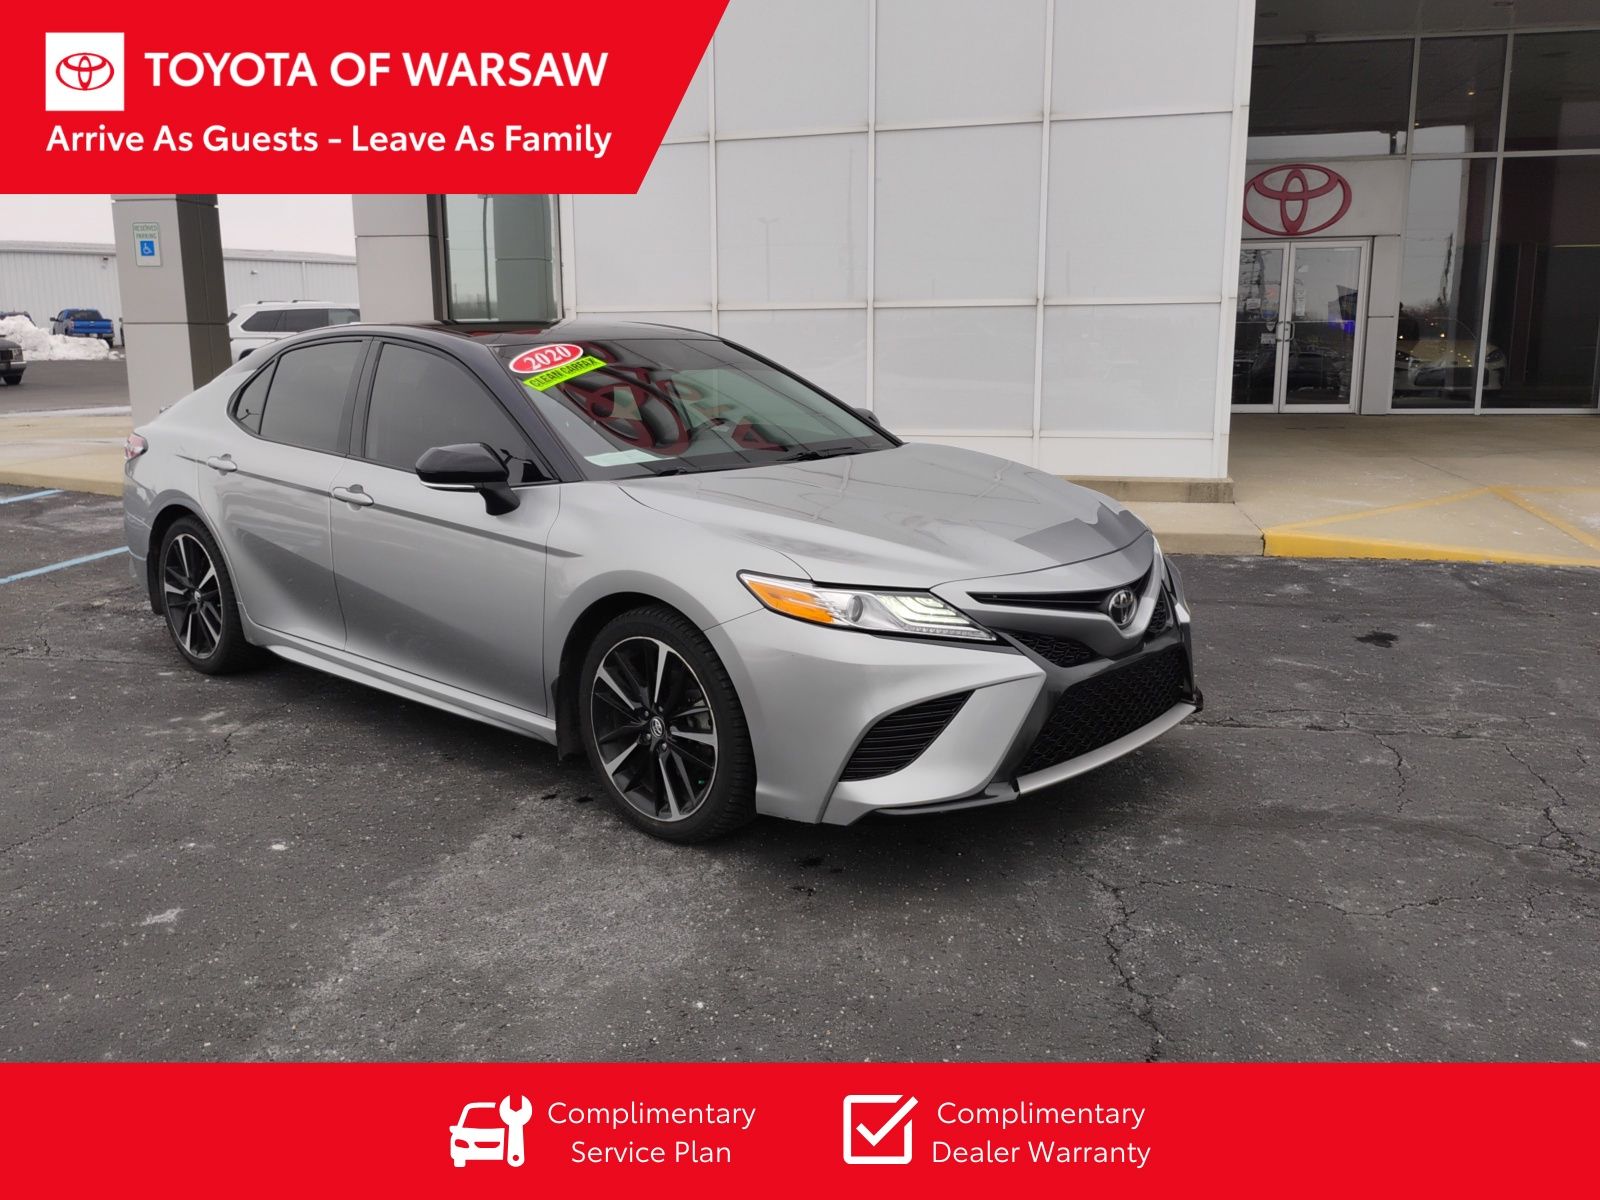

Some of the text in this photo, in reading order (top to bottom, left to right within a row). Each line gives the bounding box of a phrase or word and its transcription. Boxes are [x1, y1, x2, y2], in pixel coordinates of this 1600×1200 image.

[524, 345, 572, 370] 2020
[529, 357, 598, 387] CLEAN CARFAX
